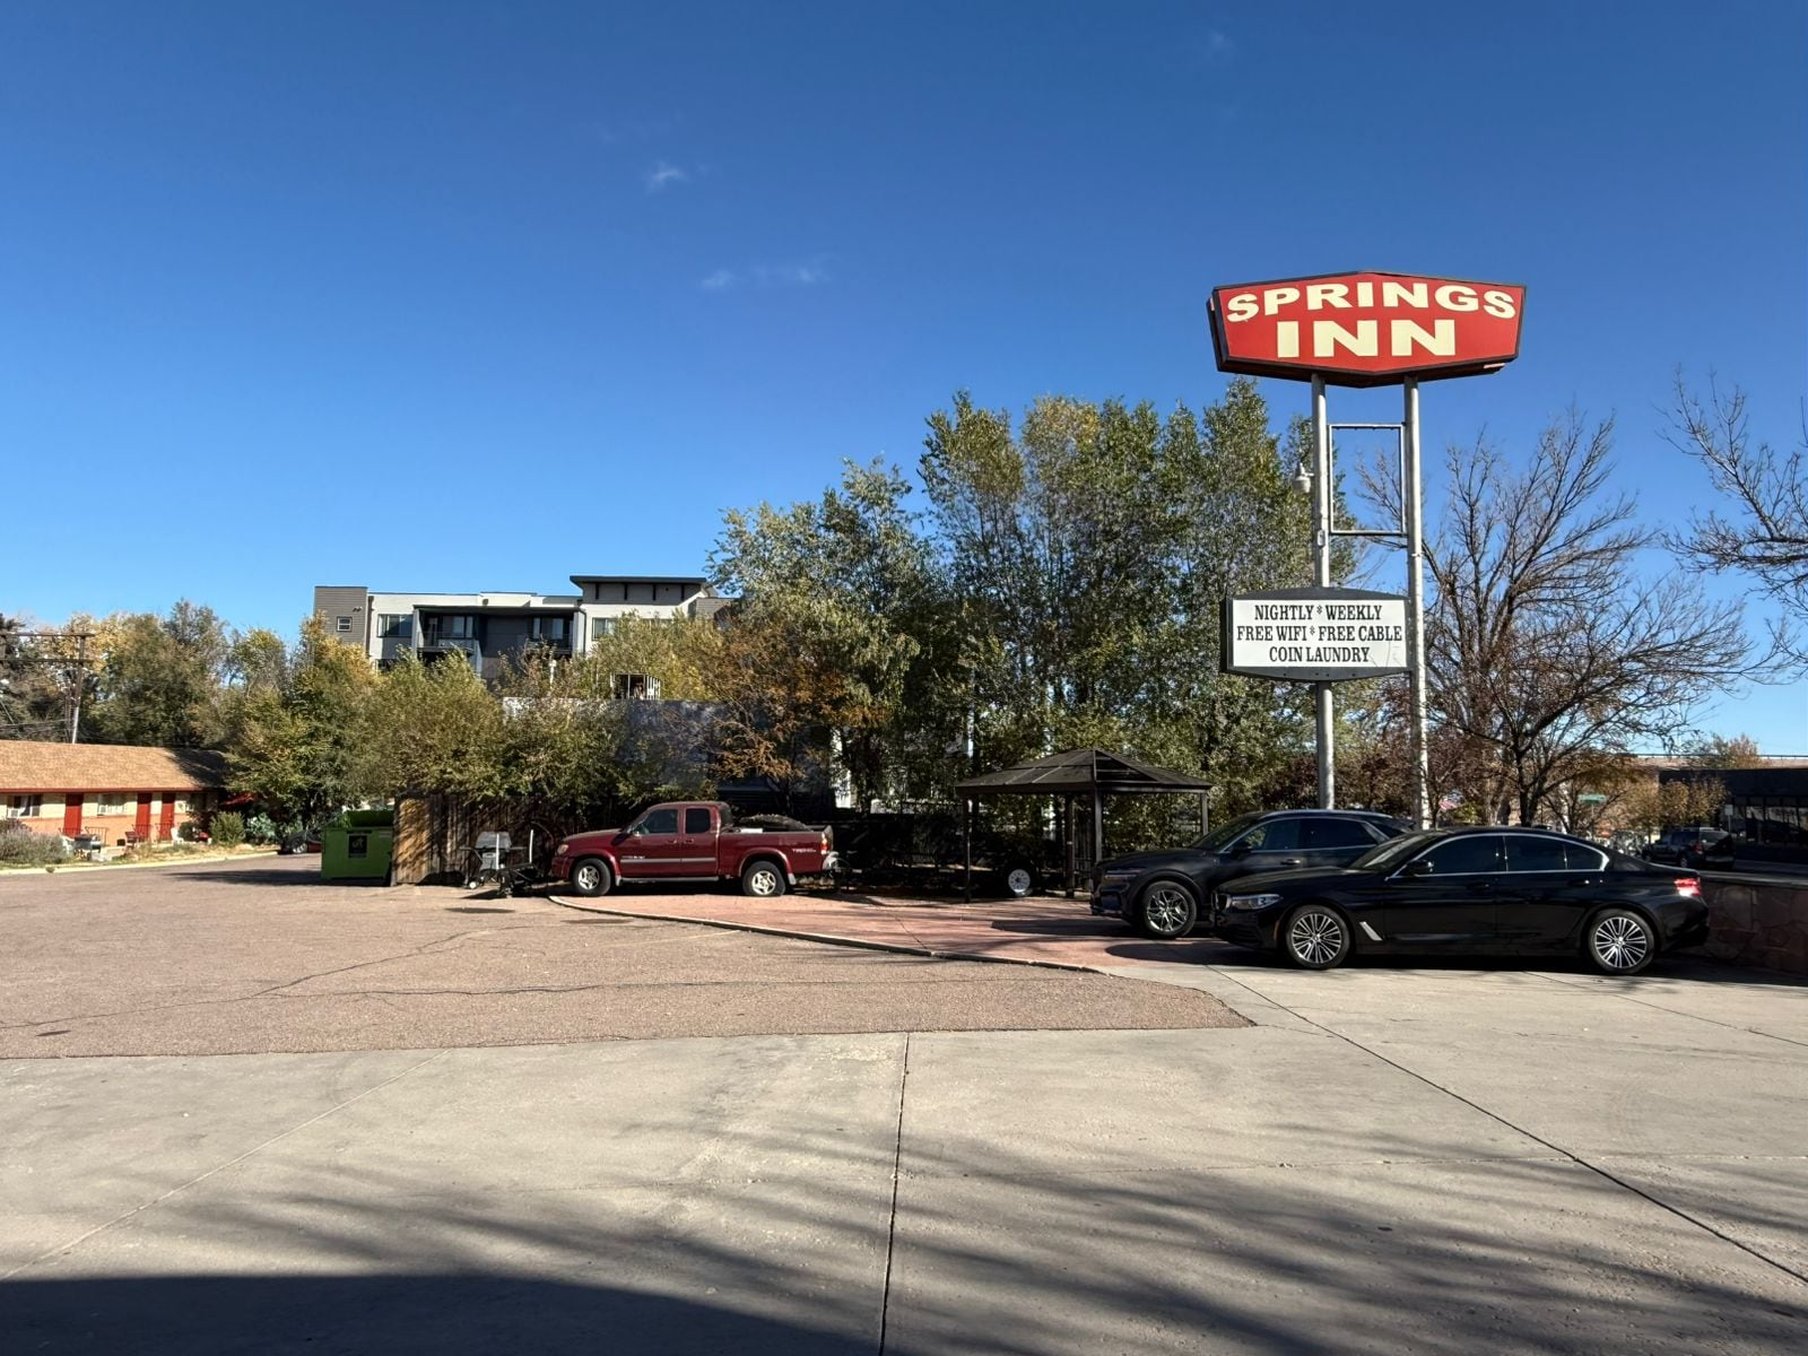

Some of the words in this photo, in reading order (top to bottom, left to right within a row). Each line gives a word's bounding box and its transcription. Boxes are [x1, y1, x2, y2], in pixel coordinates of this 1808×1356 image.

[1226, 281, 1517, 322] SPRINGS
[1276, 319, 1456, 358] INN
[1254, 604, 1314, 621] NIGHTLY
[1325, 604, 1383, 621] WEEKLY
[1237, 625, 1273, 641] FREE
[1275, 625, 1307, 641] WIFI
[1318, 625, 1356, 641] FREE
[1358, 625, 1403, 642] CABLE
[1269, 646, 1303, 662] COIN
[1305, 646, 1370, 662] LAUNDRY
